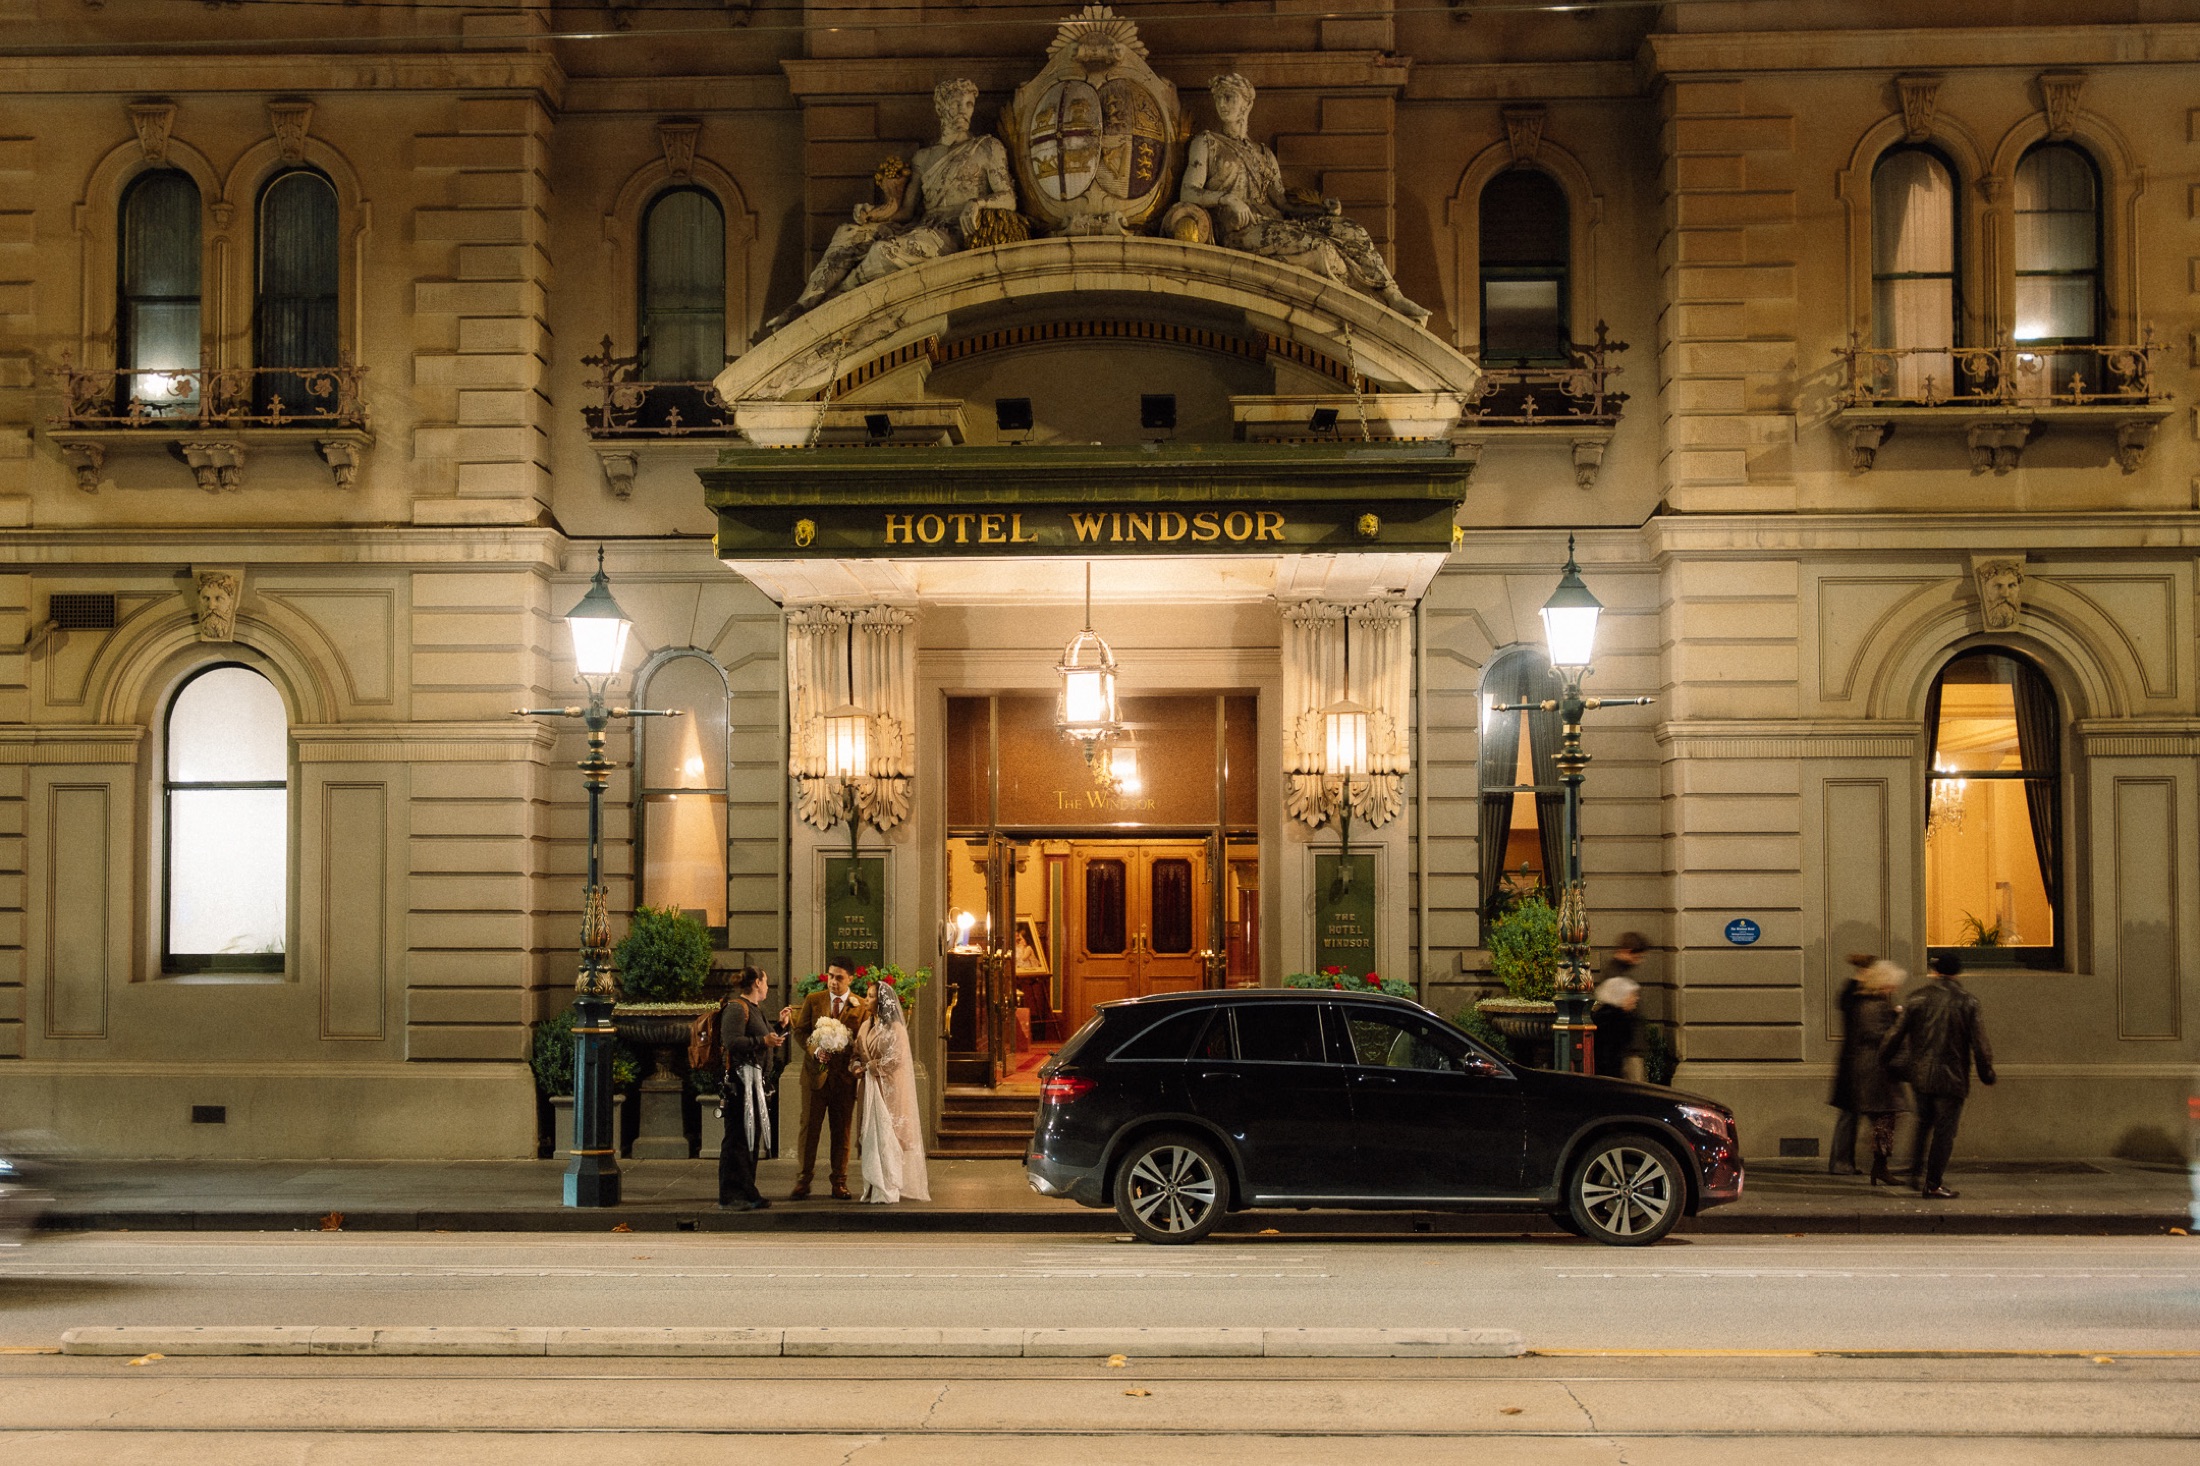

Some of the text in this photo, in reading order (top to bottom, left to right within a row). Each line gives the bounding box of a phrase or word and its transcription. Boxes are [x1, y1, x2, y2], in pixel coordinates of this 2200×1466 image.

[884, 511, 1286, 544] HOTEL WINDSOR
[1052, 790, 1156, 811] THE WINDOR
[844, 915, 865, 923] THE
[1335, 913, 1355, 921] THE
[838, 927, 872, 937] HOTEL
[1328, 925, 1363, 935] HOTEL
[832, 941, 879, 950] WINDSOR
[1323, 938, 1370, 948] WINDSOR
